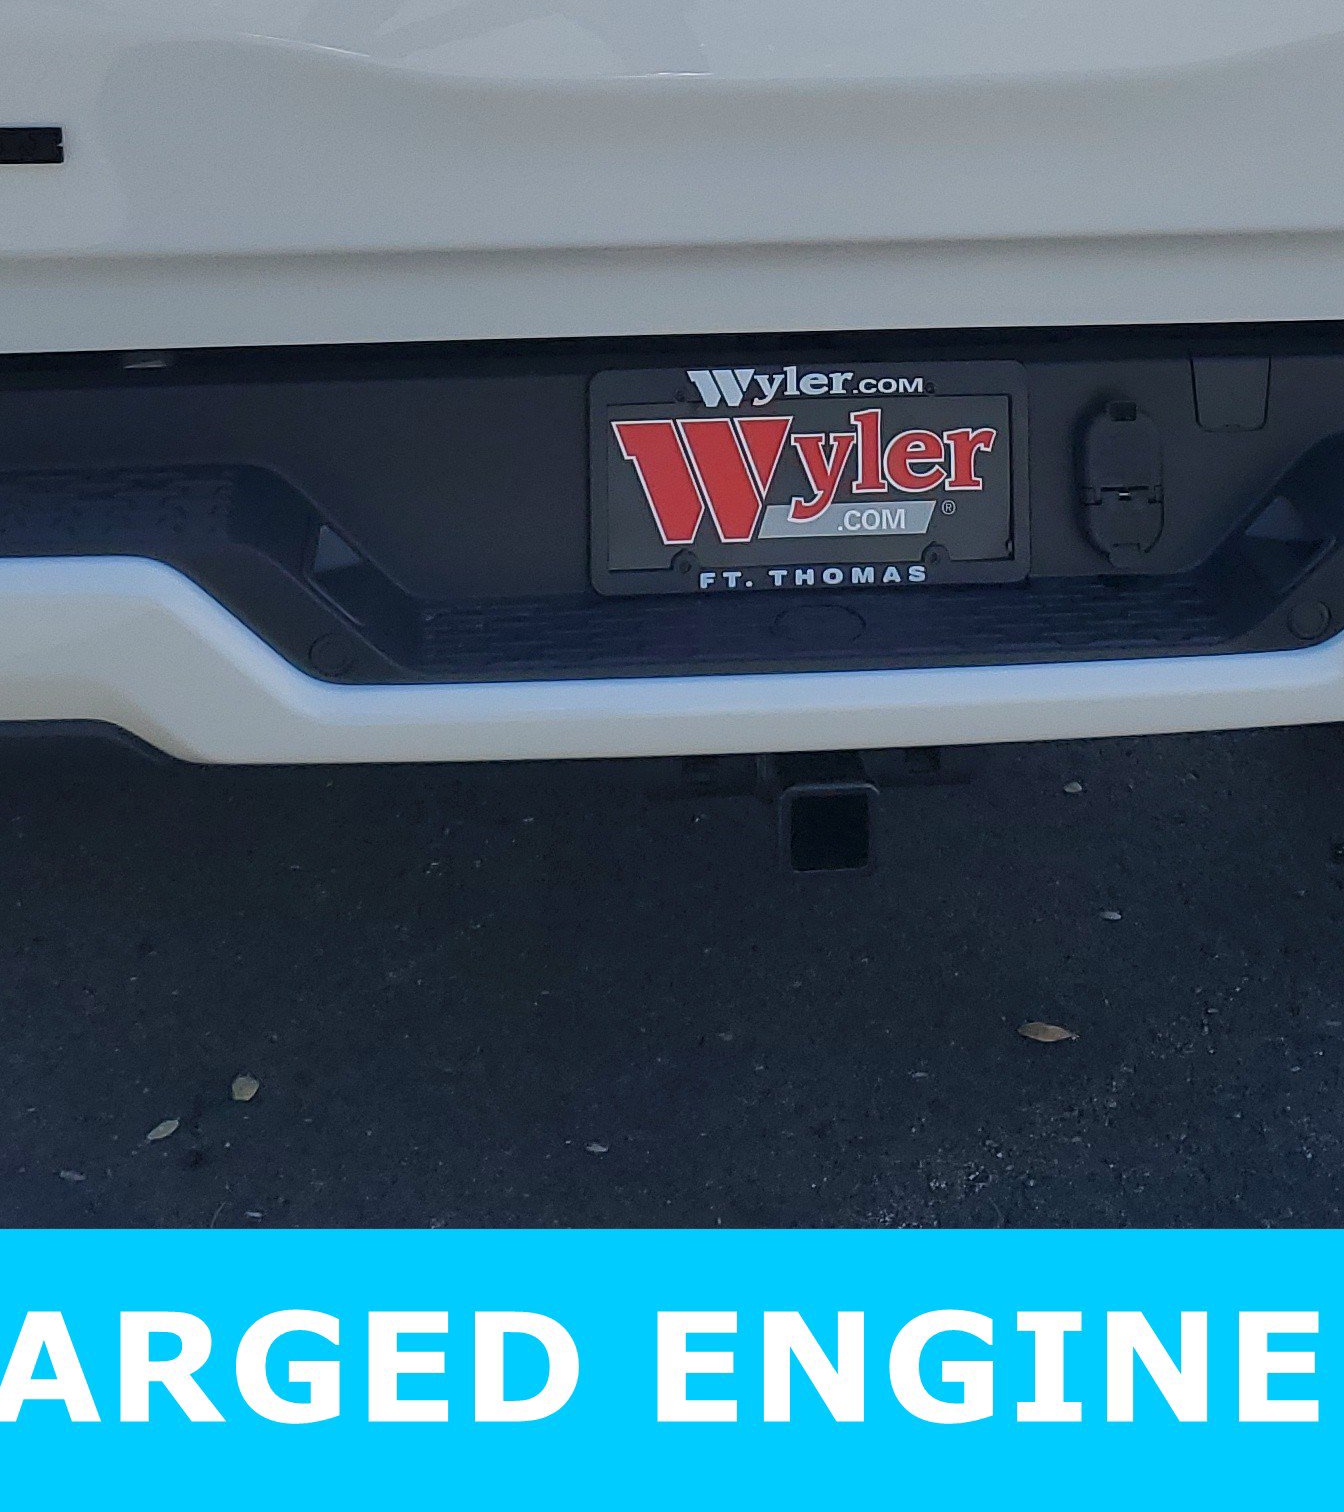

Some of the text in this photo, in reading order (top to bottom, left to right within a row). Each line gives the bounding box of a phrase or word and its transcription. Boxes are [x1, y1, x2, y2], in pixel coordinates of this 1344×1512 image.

[610, 408, 997, 545] Wyler
[698, 565, 927, 589] FT. THOMAS
